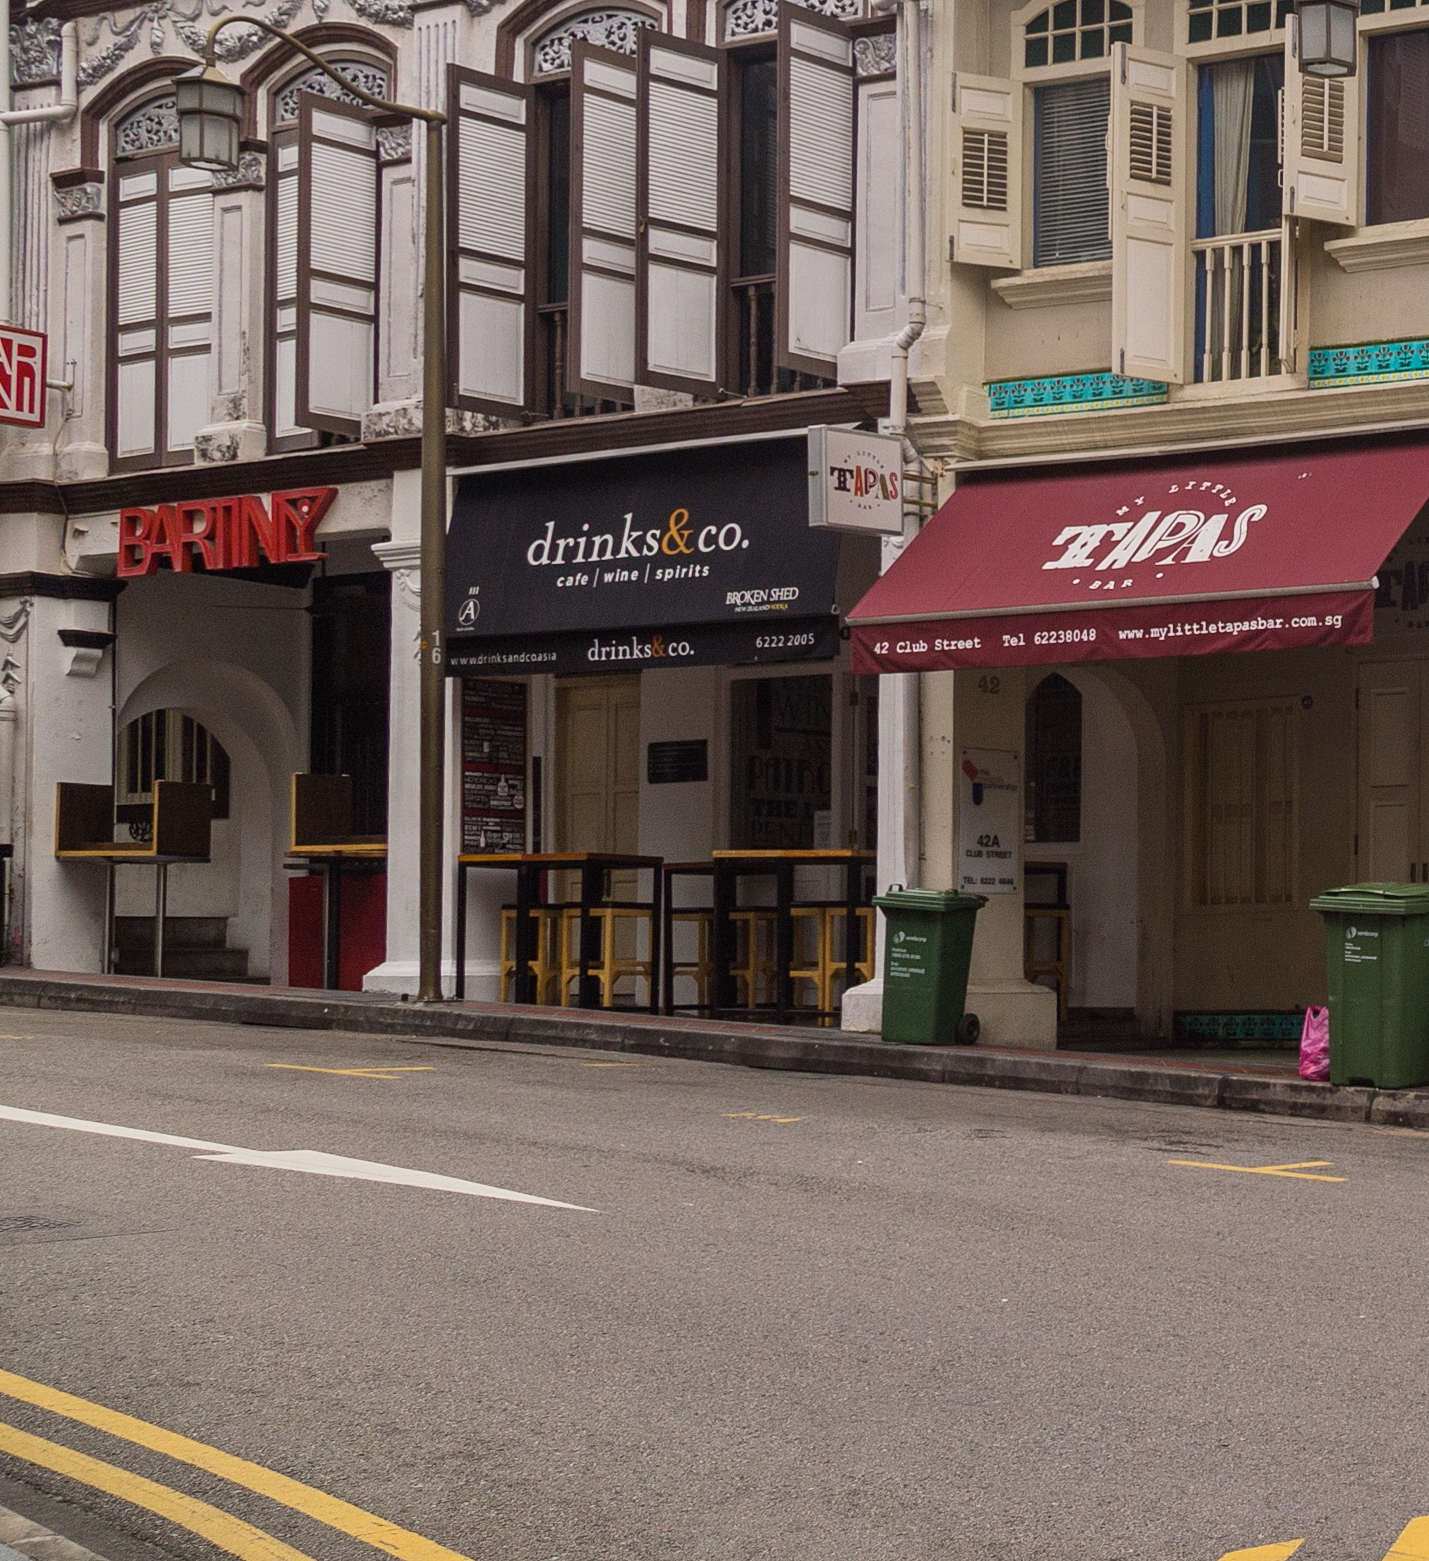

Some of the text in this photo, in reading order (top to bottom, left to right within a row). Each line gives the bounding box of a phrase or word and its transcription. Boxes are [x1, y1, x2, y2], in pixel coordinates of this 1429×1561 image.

[829, 465, 899, 501] TAPAS
[1116, 481, 1237, 516] MY LITTLE
[526, 508, 750, 566] drinks&co.
[1042, 504, 1268, 570] TAPAS
[556, 575, 589, 588] cafe
[603, 570, 639, 584] wine
[655, 564, 710, 581] spirits
[1089, 579, 1133, 589] BAR
[726, 587, 799, 606] BROKEN SHED
[1118, 614, 1343, 641] www.mylittletapasbar.com.sg
[756, 633, 815, 648] 6222 2005
[874, 637, 982, 655] 42 Club Street
[1003, 629, 1097, 647] Tel 62238048
[588, 636, 694, 661] drinks&co.
[978, 676, 1000, 694] 42
[977, 834, 1001, 849] 42A
[966, 849, 1012, 859] CLUB STREET
